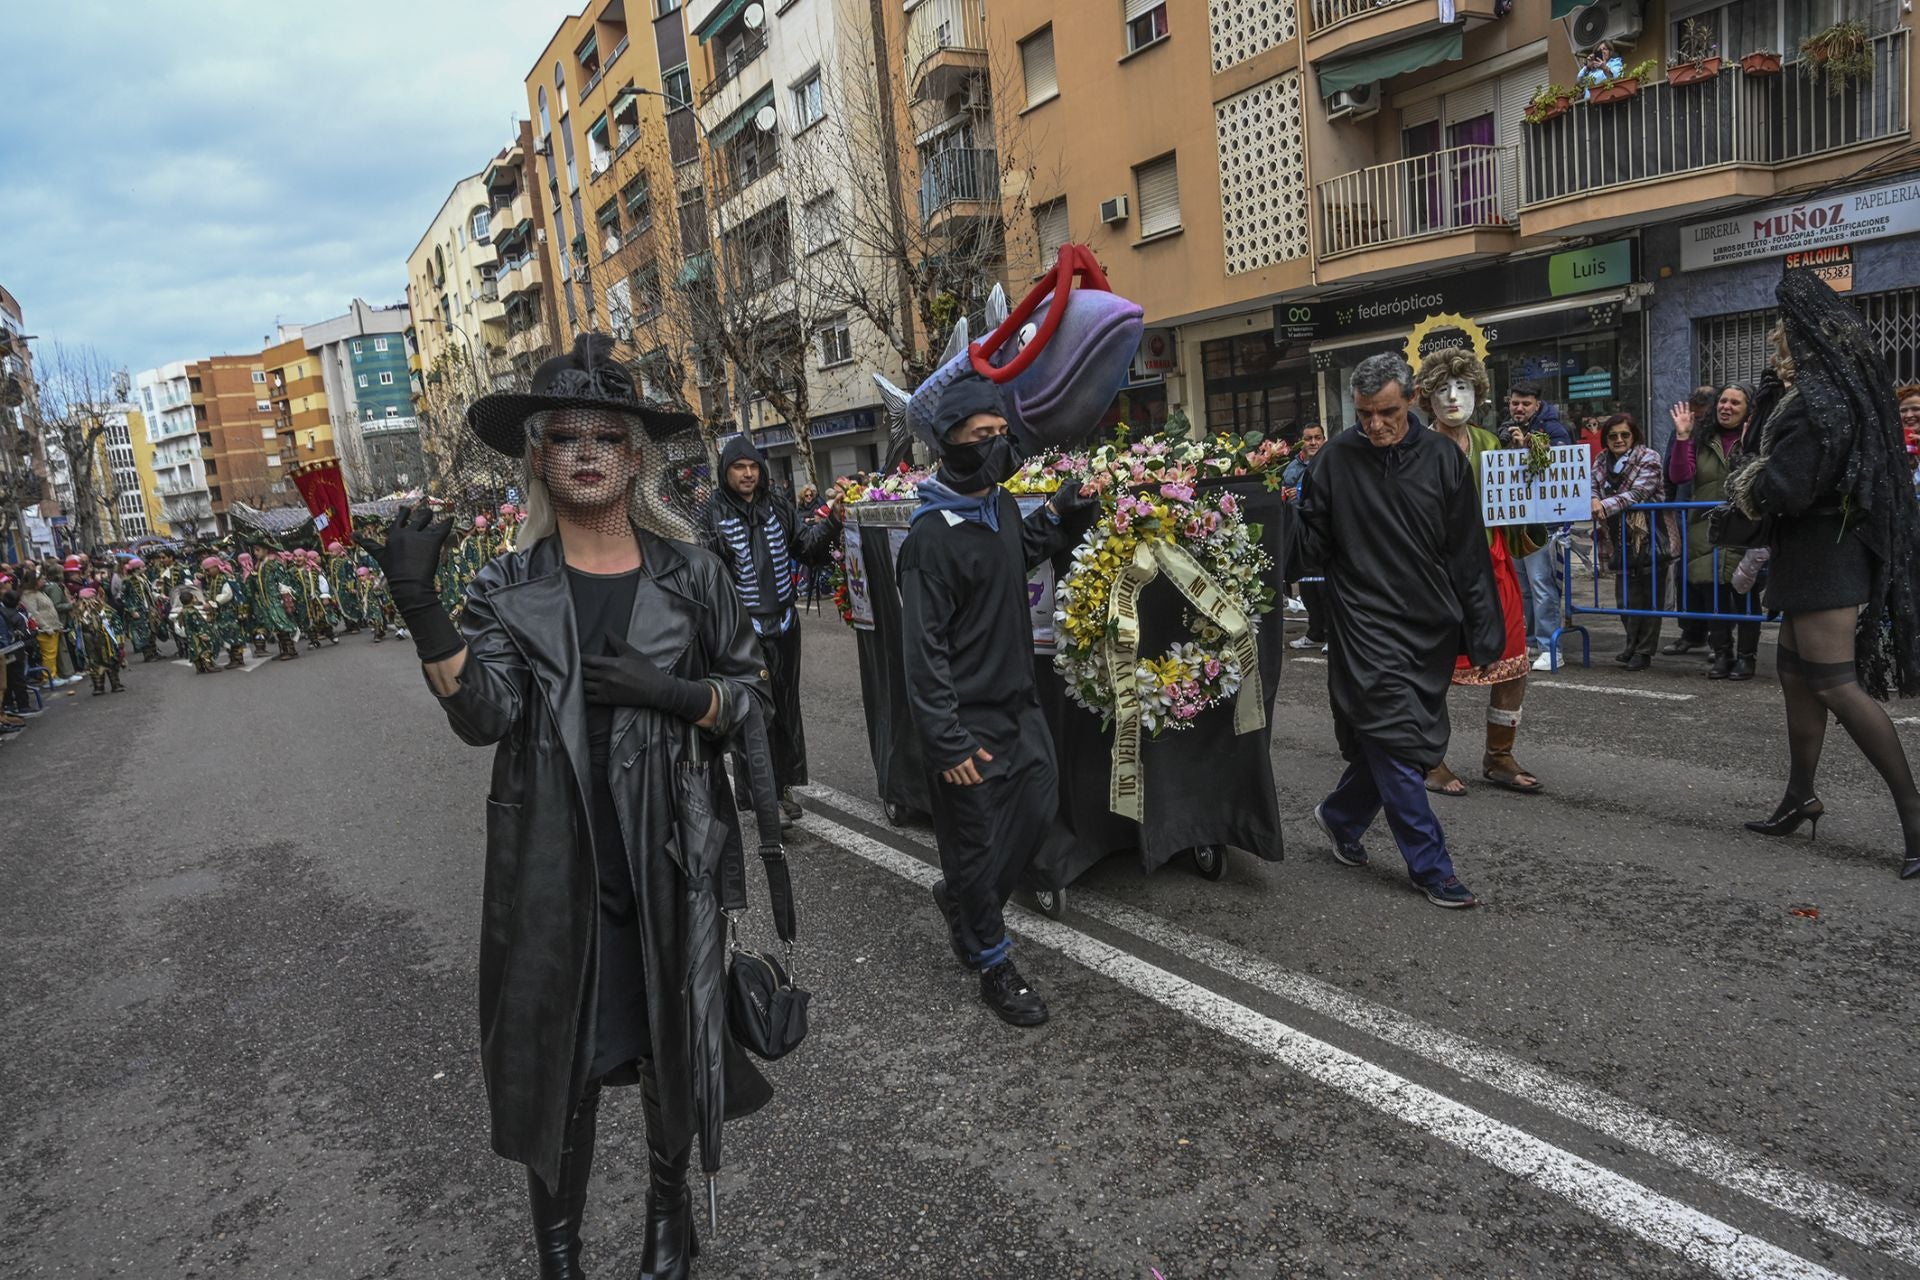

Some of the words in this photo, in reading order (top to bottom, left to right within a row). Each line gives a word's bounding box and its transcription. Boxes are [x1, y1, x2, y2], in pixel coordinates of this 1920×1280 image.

[1855, 185, 1920, 211] PAPELERIA
[1694, 221, 1741, 242] LIBRERIA
[1753, 203, 1845, 240] MUÑOZ
[1713, 245, 1736, 255] LIBROS
[1736, 242, 1747, 251] DE
[1747, 239, 1768, 249] TEXTO
[1773, 229, 1815, 244] FOTOCOPIAS
[1820, 216, 1890, 235] PLASTIFICACIONES
[1713, 251, 1743, 262] SERVICIO
[1743, 249, 1752, 257] DE
[1753, 247, 1766, 255] FAX
[1770, 240, 1802, 252] RECARGA
[1803, 238, 1812, 246] DE
[1813, 232, 1845, 244] MOVILES
[1850, 225, 1886, 238] REVISTAS
[1786, 253, 1800, 269] SE
[1802, 245, 1850, 267] ALQUILA
[1816, 265, 1850, 280] 735383
[1358, 291, 1444, 321] federópticos
[1572, 258, 1607, 281] Luis
[1549, 448, 1584, 464] OBIS
[1539, 466, 1586, 483] OMNIA
[1487, 489, 1503, 503] ET
[1509, 487, 1532, 502] EGO
[1540, 484, 1581, 500] BONA
[1487, 504, 1526, 521] DABO
[1117, 572, 1141, 619] ROQUE
[1188, 576, 1207, 598] NO
[1210, 596, 1227, 619] TE
[1115, 628, 1136, 657] SAN
[1118, 688, 1138, 709] AA
[1118, 713, 1138, 765] VECINOS
[1118, 775, 1136, 798] TUS
